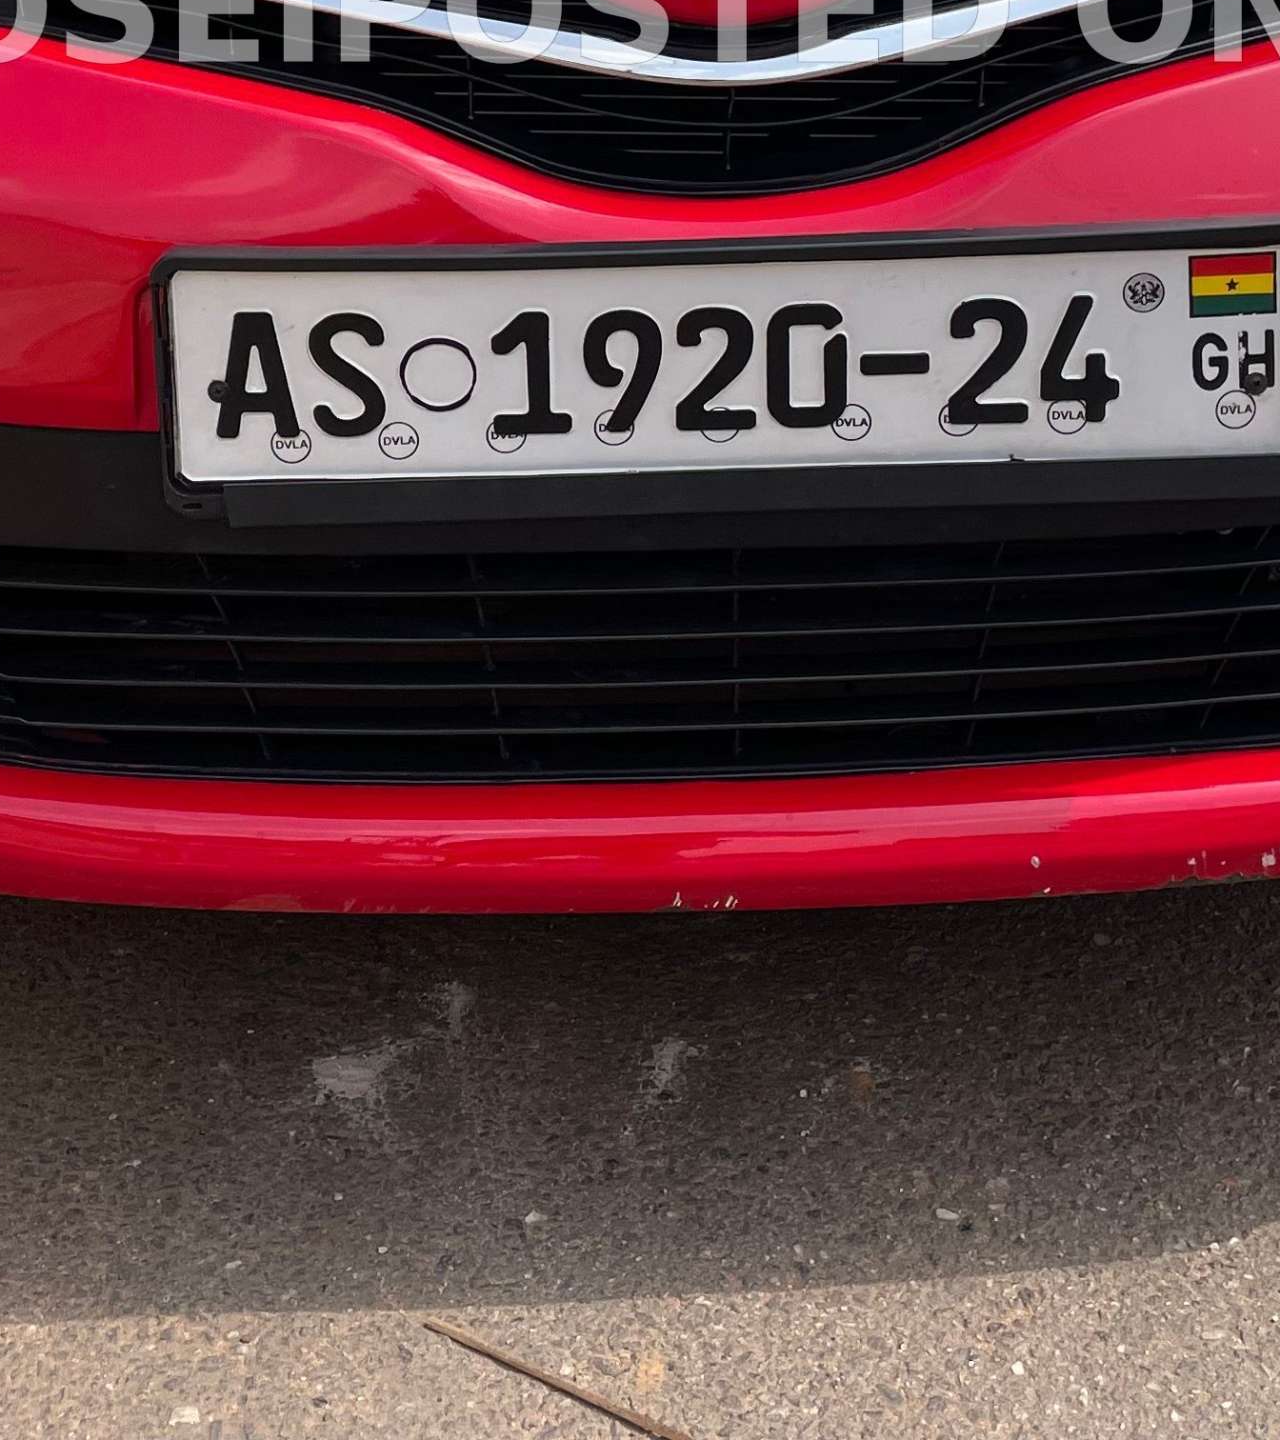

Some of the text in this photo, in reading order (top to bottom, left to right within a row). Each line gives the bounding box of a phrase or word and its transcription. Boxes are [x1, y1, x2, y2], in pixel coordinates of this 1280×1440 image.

[1192, 328, 1275, 392] GH
[216, 294, 1120, 439] AS 1920-24
[1052, 409, 1085, 421] DVLA
[1220, 404, 1253, 415] DVLA
[835, 417, 869, 427] DVLA
[275, 440, 308, 450] DVLA
[383, 435, 416, 447] DVLA
